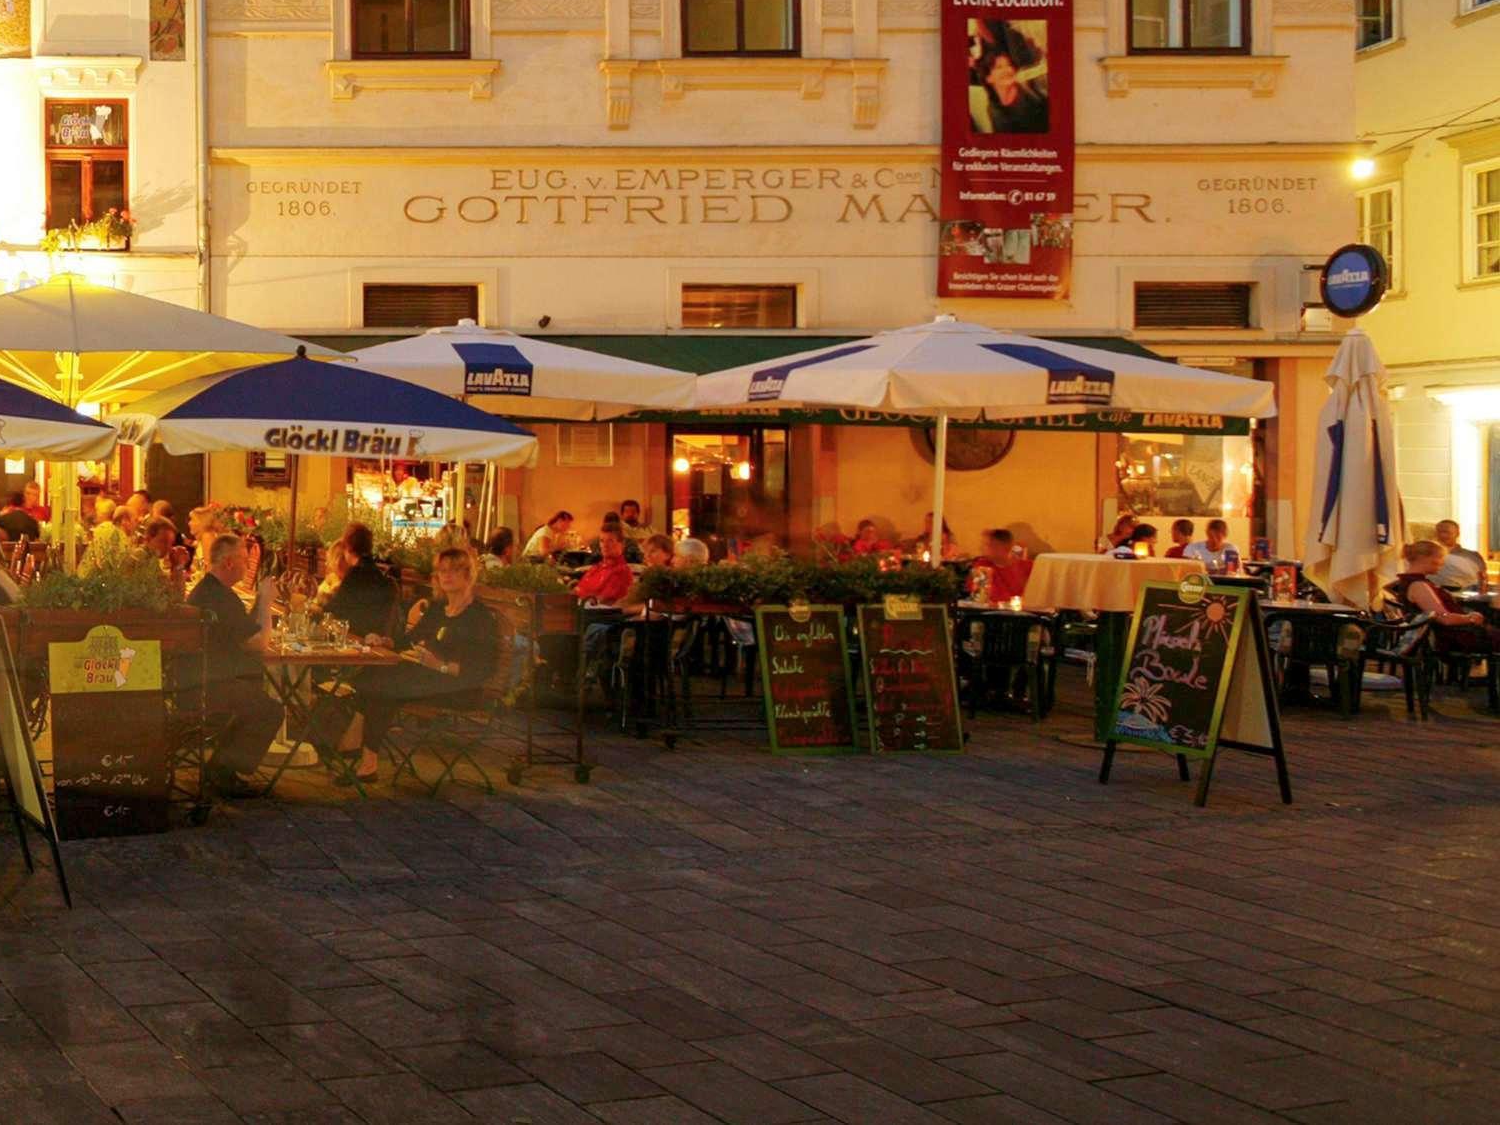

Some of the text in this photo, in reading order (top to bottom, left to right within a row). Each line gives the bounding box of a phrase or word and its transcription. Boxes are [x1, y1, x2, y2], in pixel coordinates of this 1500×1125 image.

[246, 177, 362, 196] GEGRÜNDET
[489, 169, 577, 191] EUG.
[615, 168, 841, 191] EMPERGER
[853, 175, 868, 190] &
[1197, 176, 1317, 192] GEGRÜNDET
[403, 193, 794, 225] GOTTFRIED
[467, 367, 530, 387] LAVAZZA
[1050, 375, 1111, 394] LAVAZZA
[264, 425, 403, 457] Glöckl Bräu
